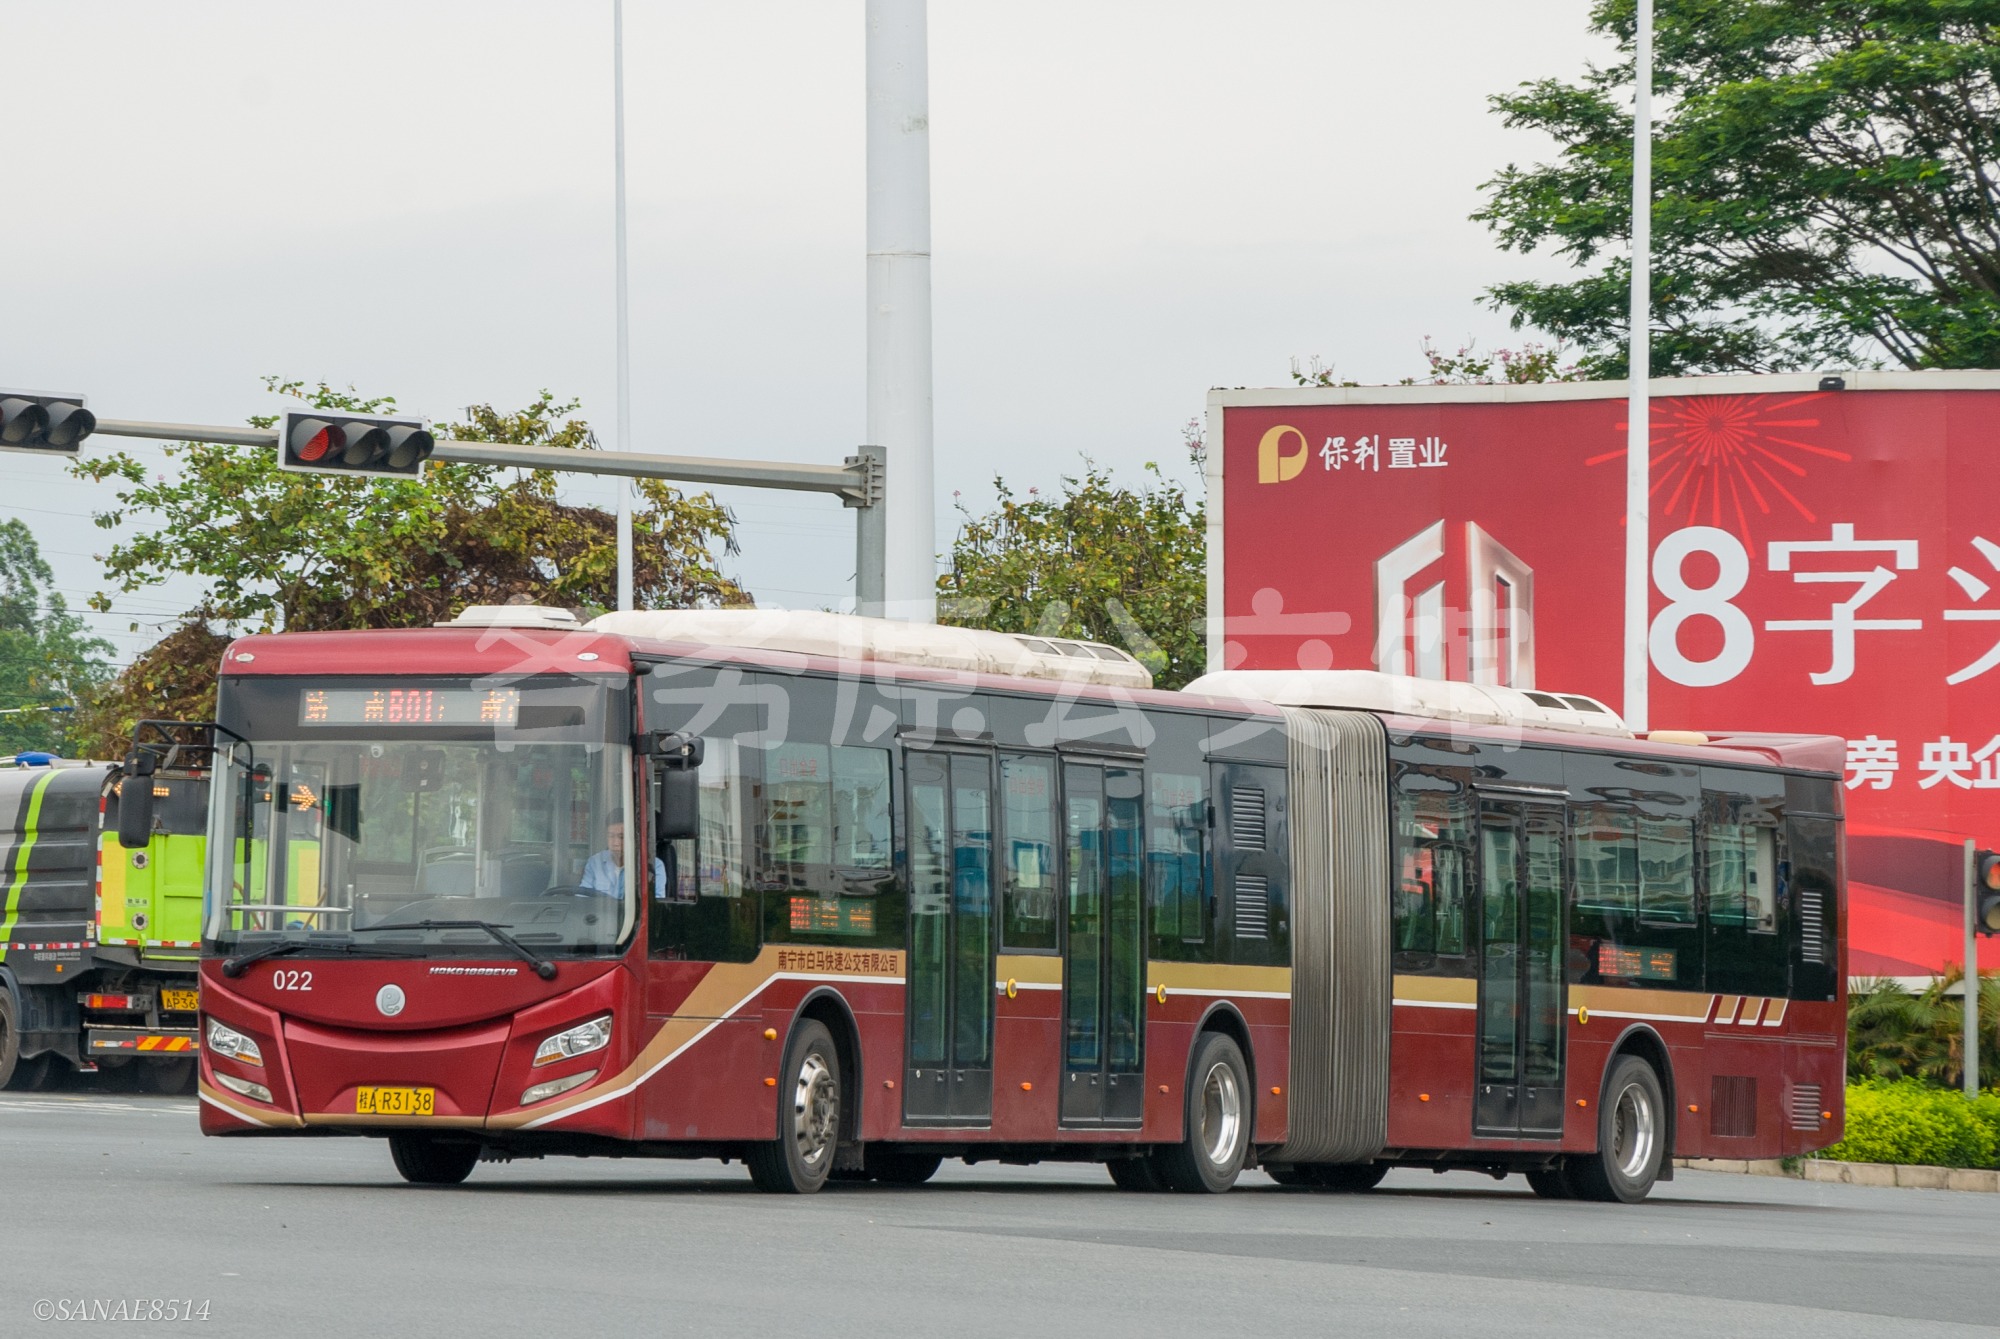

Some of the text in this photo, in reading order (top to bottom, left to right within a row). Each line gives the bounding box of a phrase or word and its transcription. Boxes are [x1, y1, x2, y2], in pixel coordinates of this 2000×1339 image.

[1318, 434, 1449, 472] 保利置业
[778, 950, 898, 974] 南宁市白马快速公交有限公司
[273, 970, 313, 991] 022
[166, 998, 199, 1010] AP36
